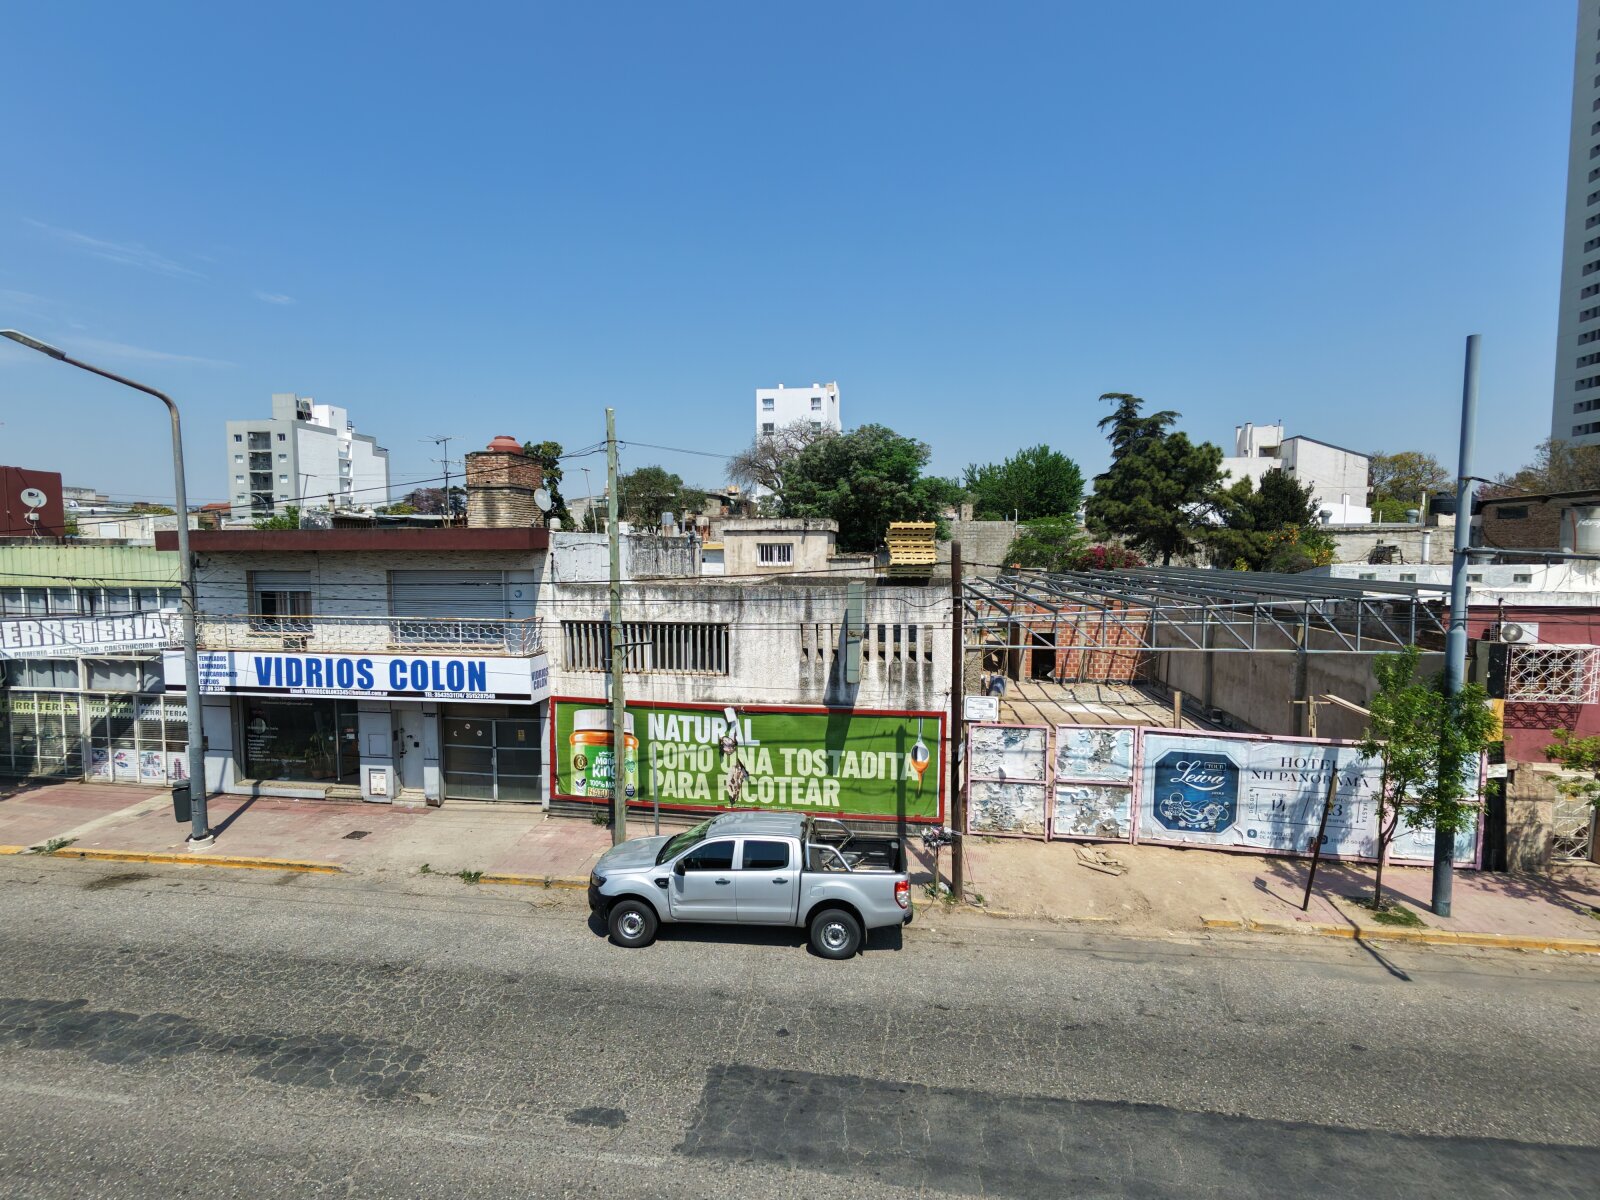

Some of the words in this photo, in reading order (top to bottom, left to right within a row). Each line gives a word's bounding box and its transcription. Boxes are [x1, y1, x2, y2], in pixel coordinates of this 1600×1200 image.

[0, 612, 167, 649] ERRETERIA
[254, 656, 374, 690] VIDRIOS
[389, 659, 486, 692] COLON
[648, 713, 760, 746] NATURAL
[648, 741, 713, 772] COMO
[720, 747, 774, 775] UNA
[780, 748, 919, 781] TOSTADITA
[1170, 760, 1225, 788] Leiva
[1251, 770, 1272, 780] NH
[648, 769, 711, 800] PARA
[718, 773, 840, 807] PCOTEAR
